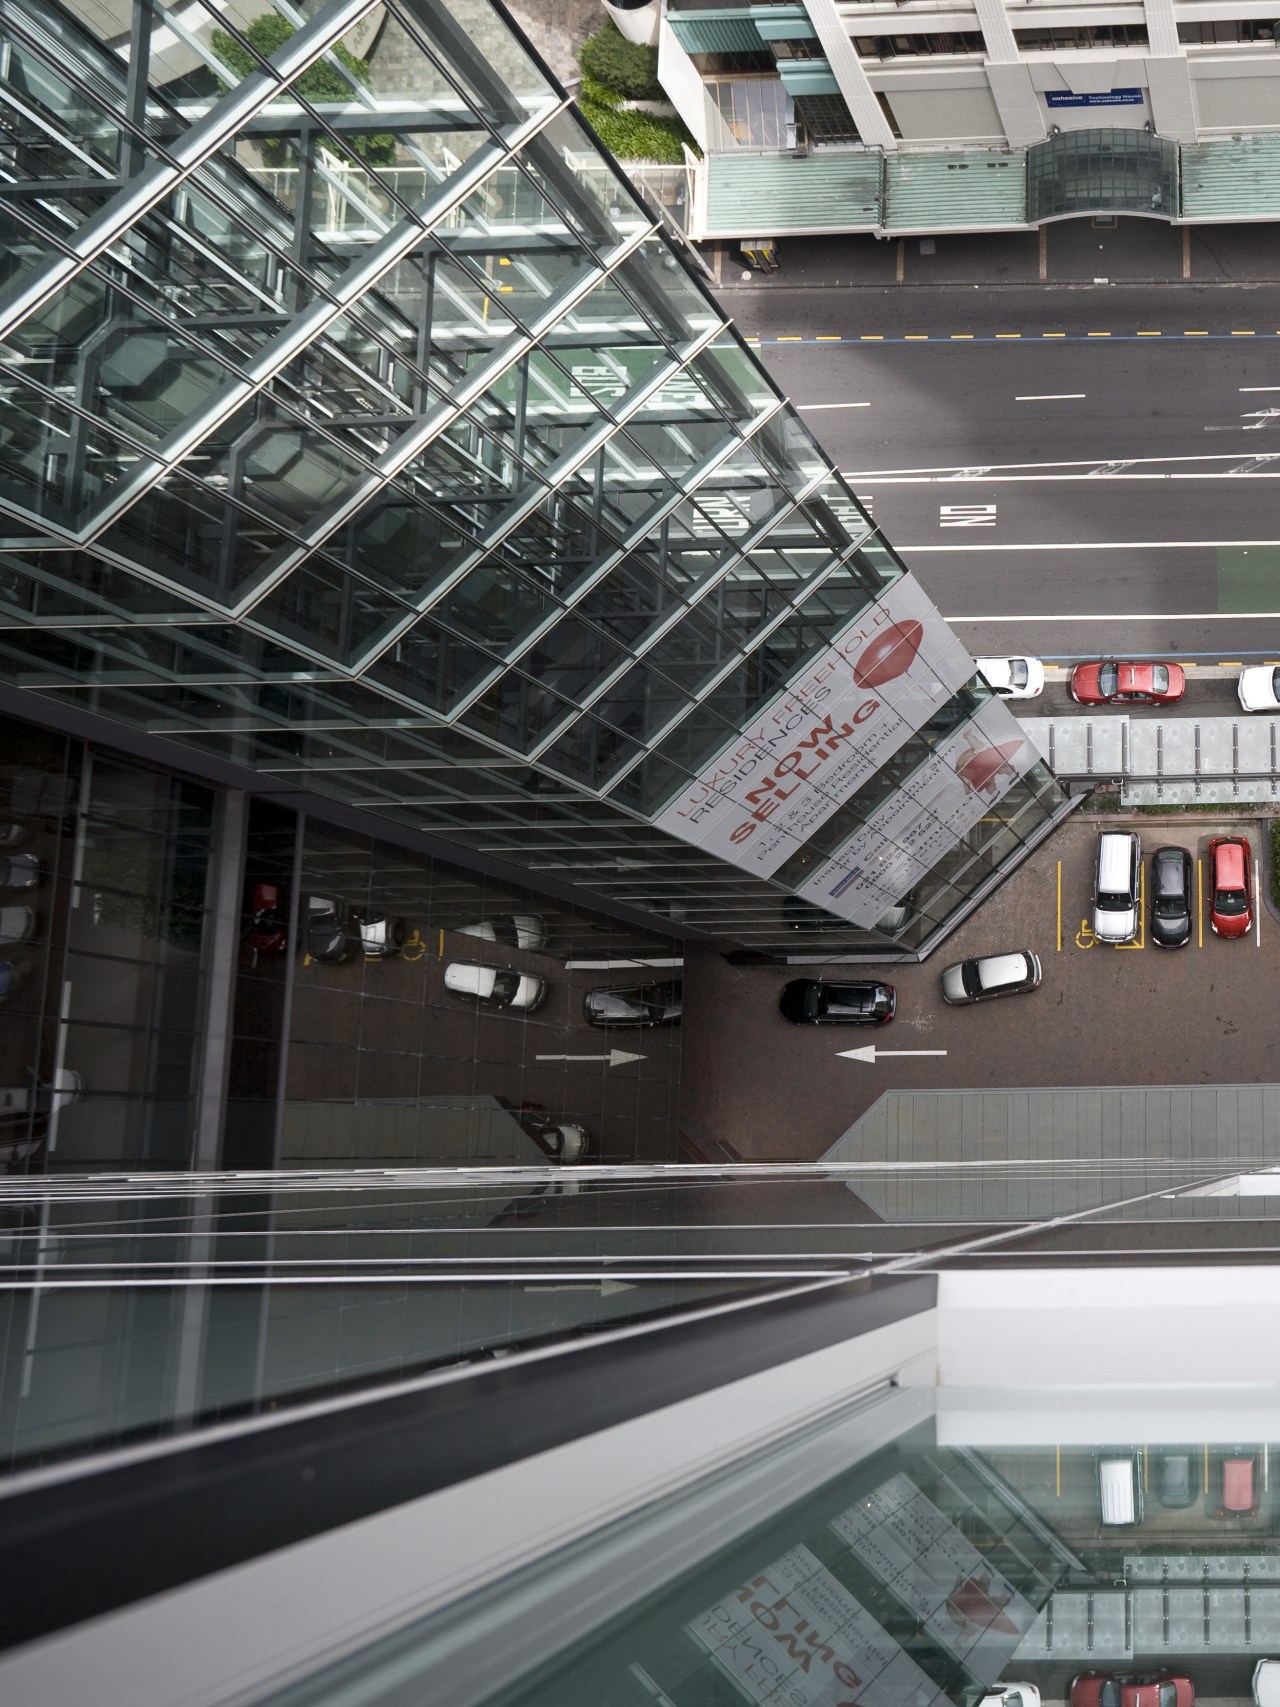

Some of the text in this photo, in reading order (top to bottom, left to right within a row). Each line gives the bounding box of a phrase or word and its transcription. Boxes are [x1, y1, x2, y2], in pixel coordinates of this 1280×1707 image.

[940, 505, 996, 527] NO
[674, 605, 892, 818] LUXURY FREEHOLD
[688, 683, 832, 824] RESIDENCES
[727, 694, 881, 847] SELLING
[744, 712, 840, 806] NOW
[755, 715, 903, 862] Penthouse Residential
[797, 753, 876, 833] Apartments
[813, 730, 877, 795] Bedroom
[867, 766, 941, 840] Appointment
[812, 843, 856, 886] Inspect
[856, 813, 887, 843] Daily
